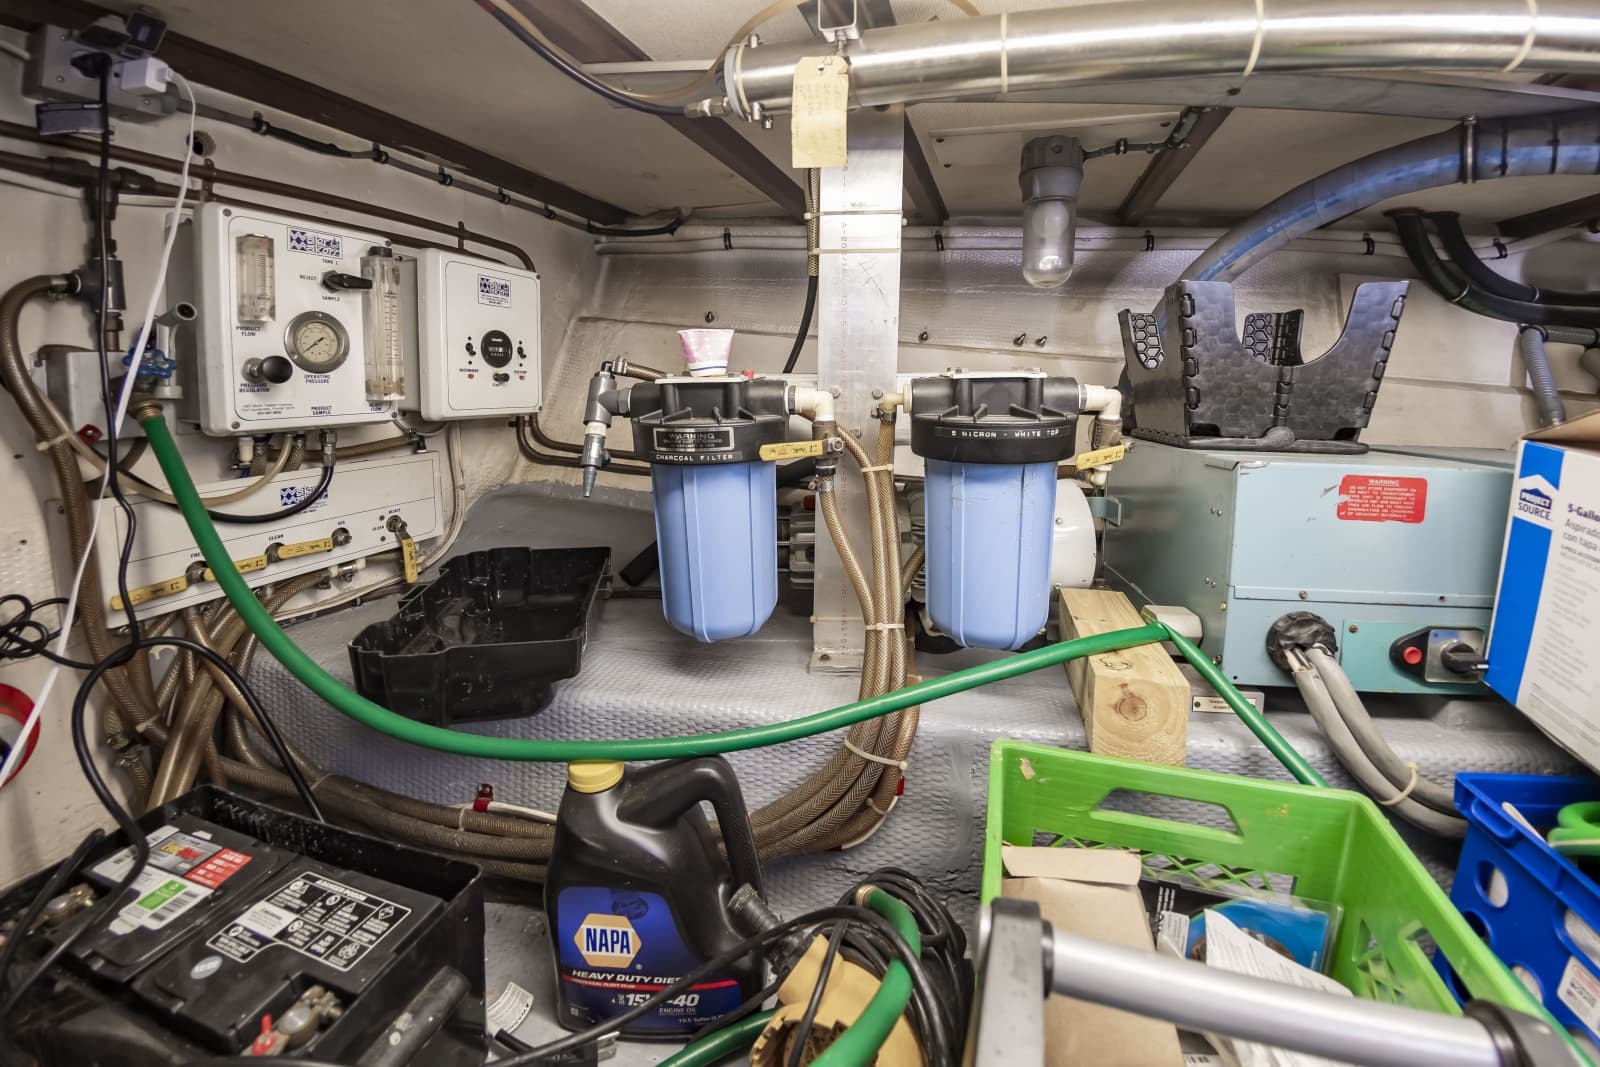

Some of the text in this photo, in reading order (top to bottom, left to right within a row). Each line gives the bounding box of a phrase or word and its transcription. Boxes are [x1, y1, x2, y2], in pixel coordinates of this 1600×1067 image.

[1014, 430, 1041, 438] WHITE
[1046, 428, 1059, 436] TOP
[1521, 492, 1551, 509] PROJECT
[1518, 502, 1551, 520] SOURCE
[268, 534, 284, 542] CLEAN
[1562, 532, 1598, 552] con tapa
[585, 927, 631, 954] NAPA
[572, 970, 681, 984] HEAVY DUTY DIE
[626, 993, 700, 1007] 15-40
